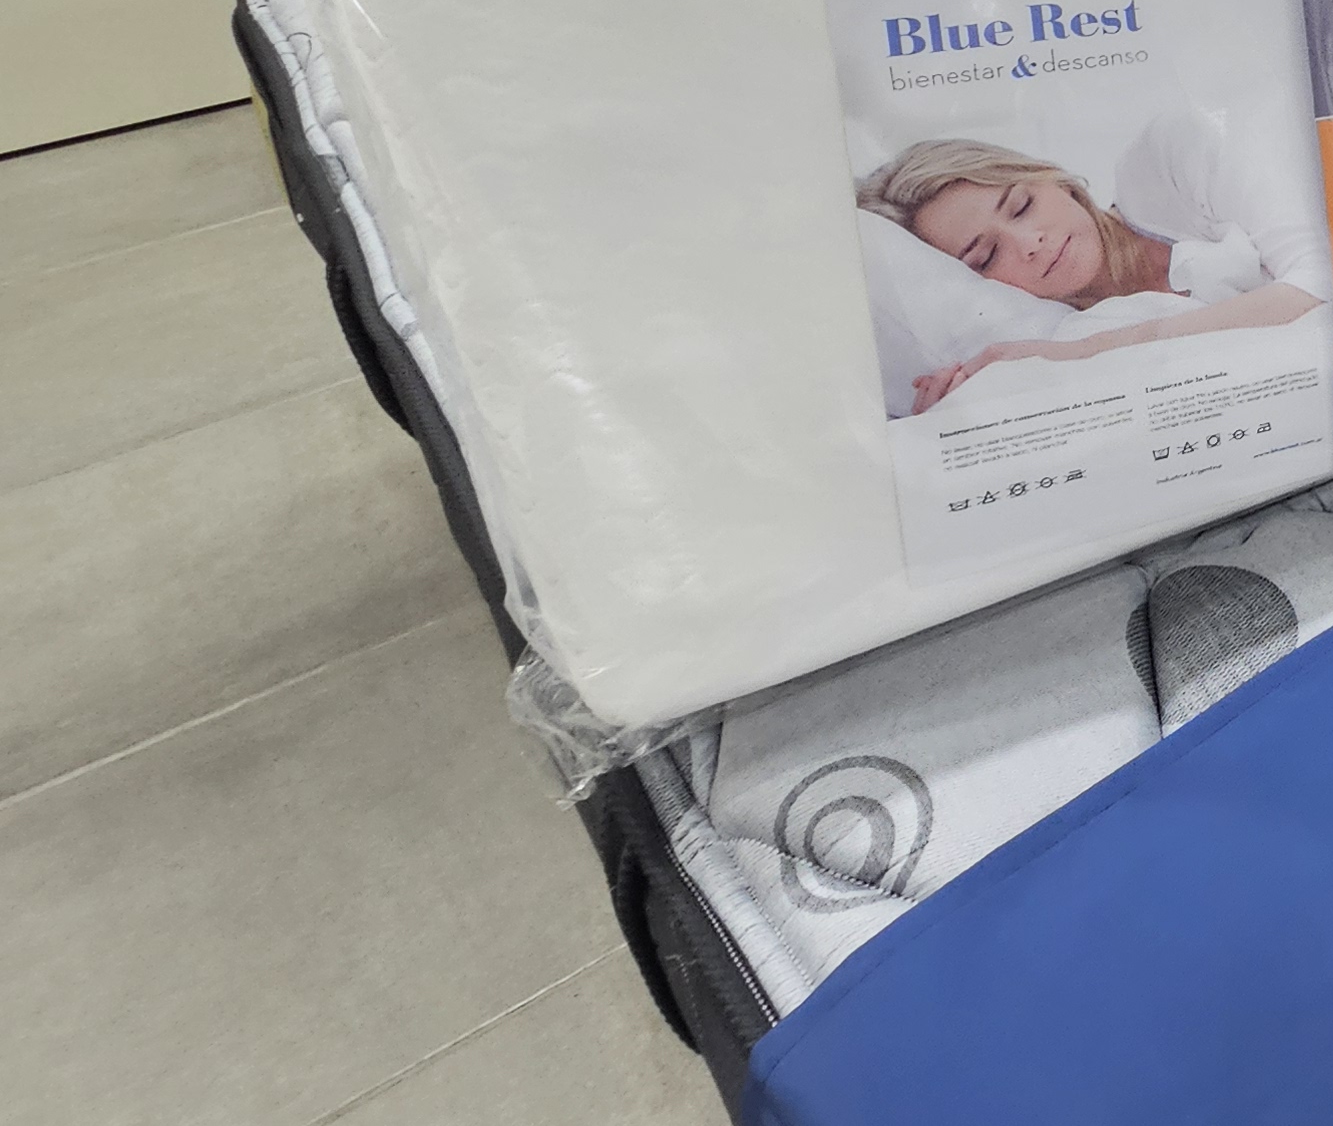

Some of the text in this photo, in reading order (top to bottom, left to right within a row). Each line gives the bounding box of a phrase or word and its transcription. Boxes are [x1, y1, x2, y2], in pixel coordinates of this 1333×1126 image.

[881, 13, 1015, 58] Blue
[890, 49, 1149, 91] bienestar & descanso
